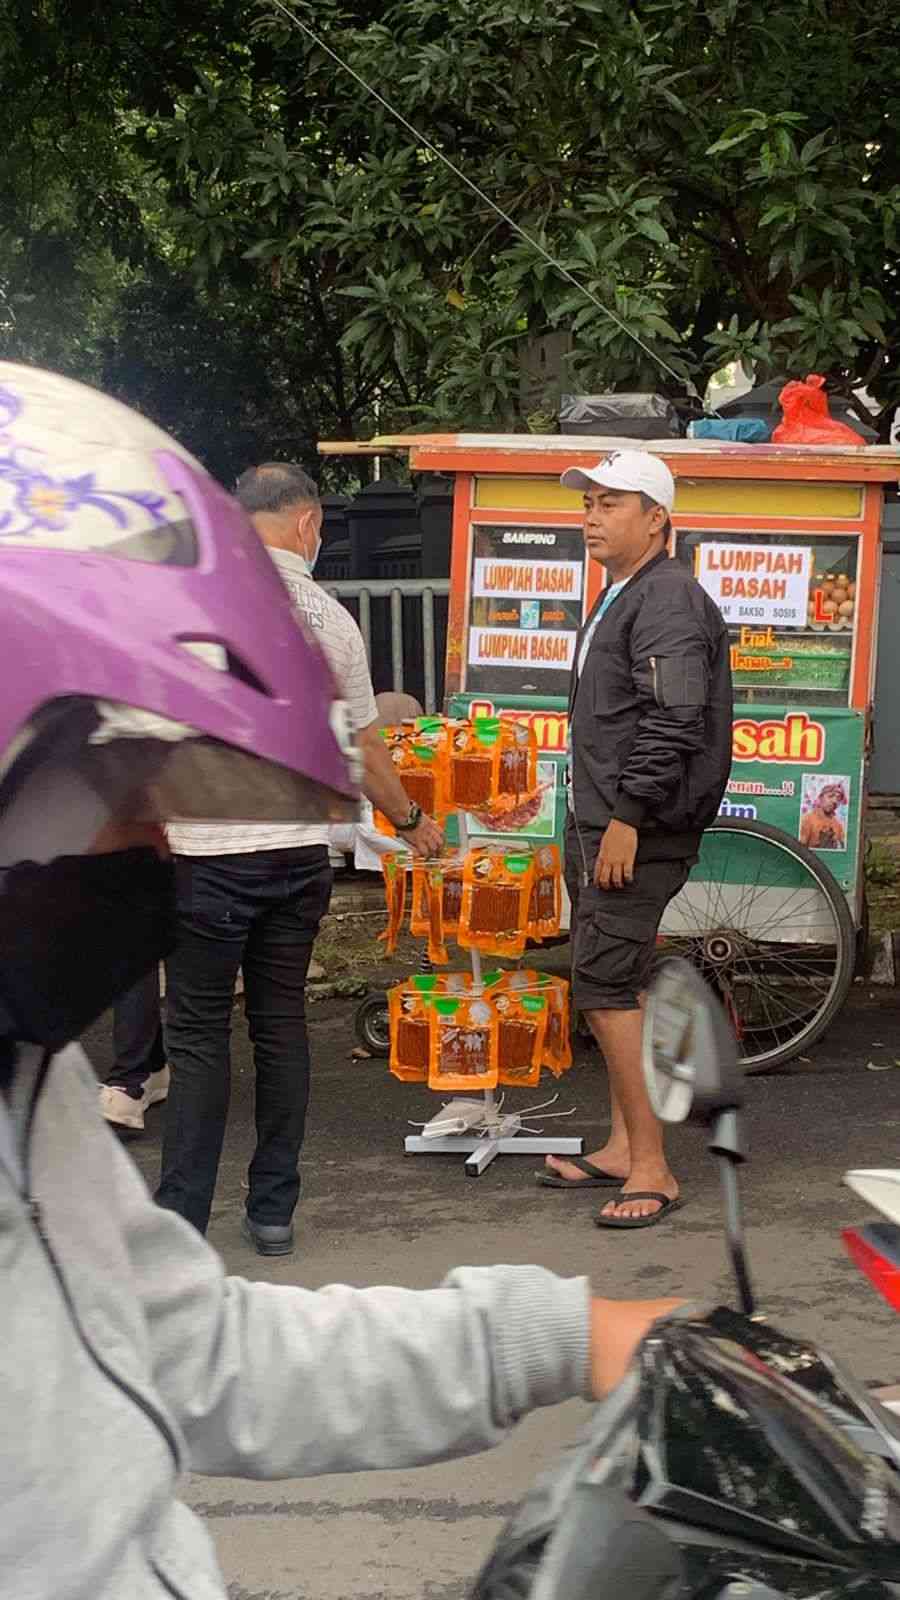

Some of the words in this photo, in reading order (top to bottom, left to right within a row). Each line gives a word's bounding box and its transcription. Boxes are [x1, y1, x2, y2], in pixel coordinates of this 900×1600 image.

[707, 550, 804, 574] LUMPIAH
[483, 564, 533, 592] LUMPIAH
[535, 567, 574, 593] BASAH
[720, 577, 788, 601] BASAH
[739, 606, 765, 617] BAKSO
[772, 607, 797, 618] SOSIS
[478, 633, 528, 660] LUMPIAH
[530, 635, 569, 662] BASAH
[732, 712, 825, 765] sah
